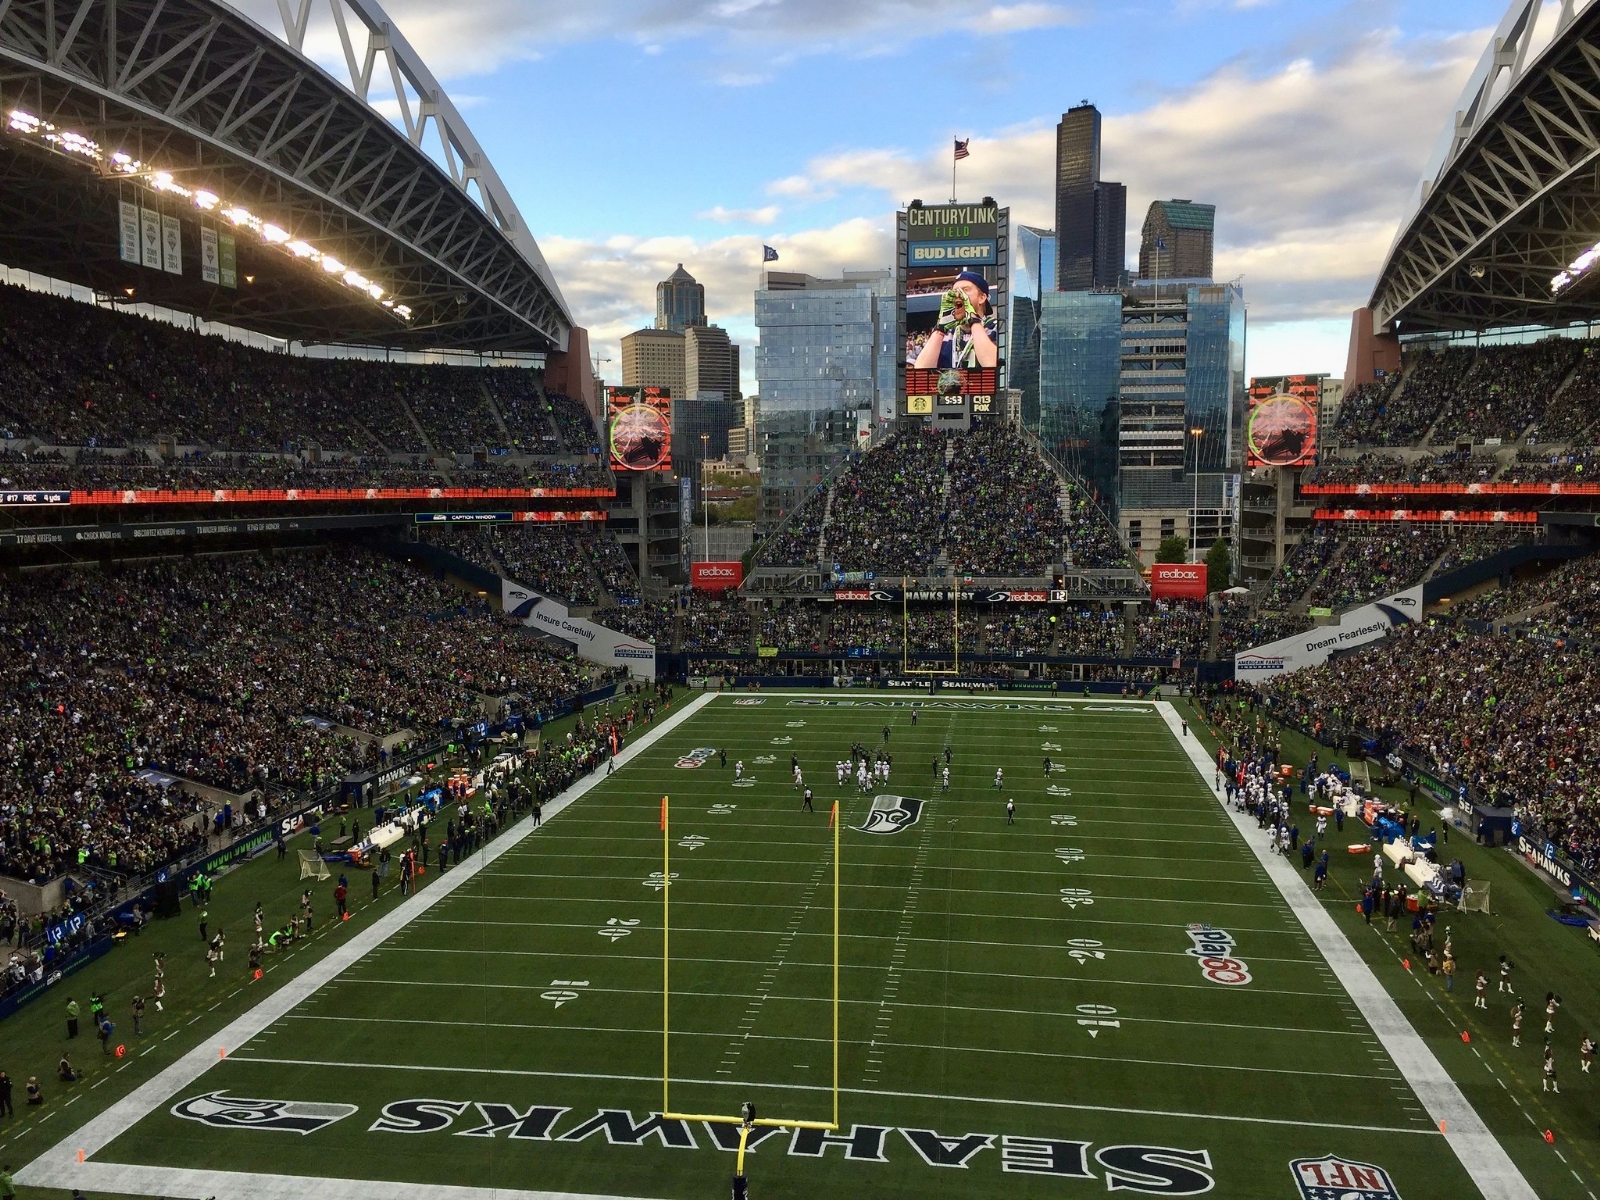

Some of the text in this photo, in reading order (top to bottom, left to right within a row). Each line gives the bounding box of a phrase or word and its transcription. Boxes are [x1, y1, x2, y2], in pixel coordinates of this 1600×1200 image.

[910, 206, 996, 226] CENTURYLINK
[935, 226, 970, 238] FIELD
[914, 245, 989, 260] BUD LIGHT
[973, 395, 991, 404] Q13
[974, 403, 990, 412] FOX
[49, 494, 61, 502] yds
[16, 535, 24, 544] 17
[24, 535, 36, 543] DAVE
[37, 534, 52, 543] KRIEG
[84, 531, 99, 540] CHUCK
[100, 531, 111, 539] KNOX
[156, 528, 175, 536] KENNEDY
[906, 592, 943, 600] HAWKS
[948, 592, 974, 600] NEST
[536, 611, 596, 641] Insure Carefully
[1306, 622, 1386, 652] Dream Fearlessly
[786, 700, 1074, 710] SEAHAWKS
[477, 722, 486, 735] 12
[378, 764, 412, 787] HAWKS
[1544, 842, 1553, 859] 12
[1518, 835, 1571, 886] SEAHAWKS
[1060, 888, 1094, 905] 30
[51, 917, 82, 943] 12 12
[597, 917, 641, 936] 20
[1067, 938, 1106, 960] 20
[1202, 958, 1247, 983] 60
[540, 980, 590, 1000] 10
[1076, 1004, 1120, 1028] 10
[368, 1099, 1215, 1195] SEAHAWKS
[1302, 1163, 1384, 1191] NFL
